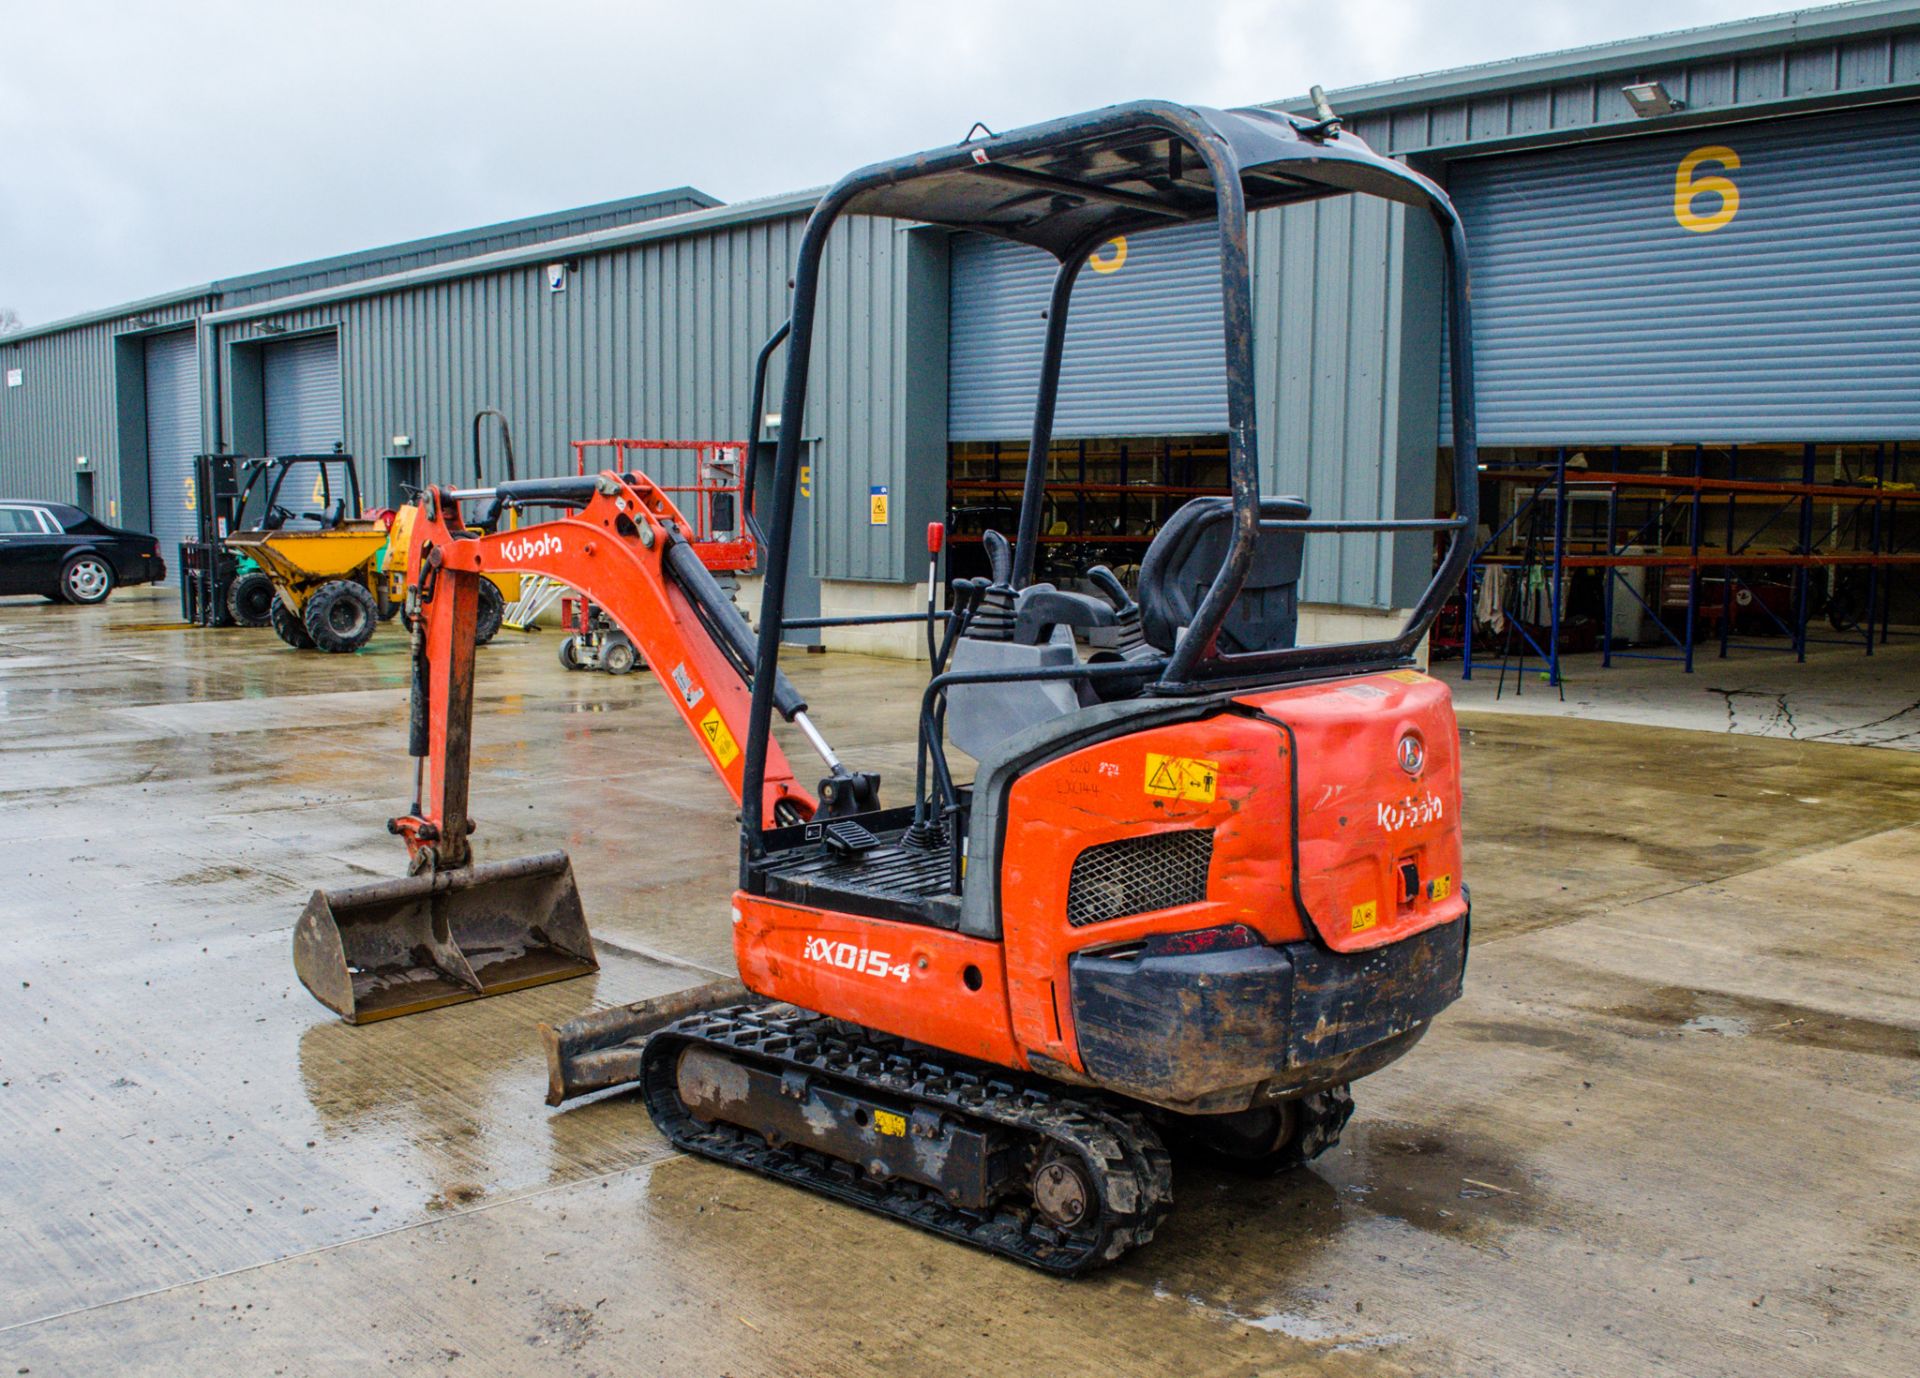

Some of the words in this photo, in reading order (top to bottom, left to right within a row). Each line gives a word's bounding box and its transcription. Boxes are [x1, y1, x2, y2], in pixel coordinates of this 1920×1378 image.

[1674, 145, 1741, 233] 6
[183, 476, 196, 511] 3
[500, 532, 563, 563] Kubota
